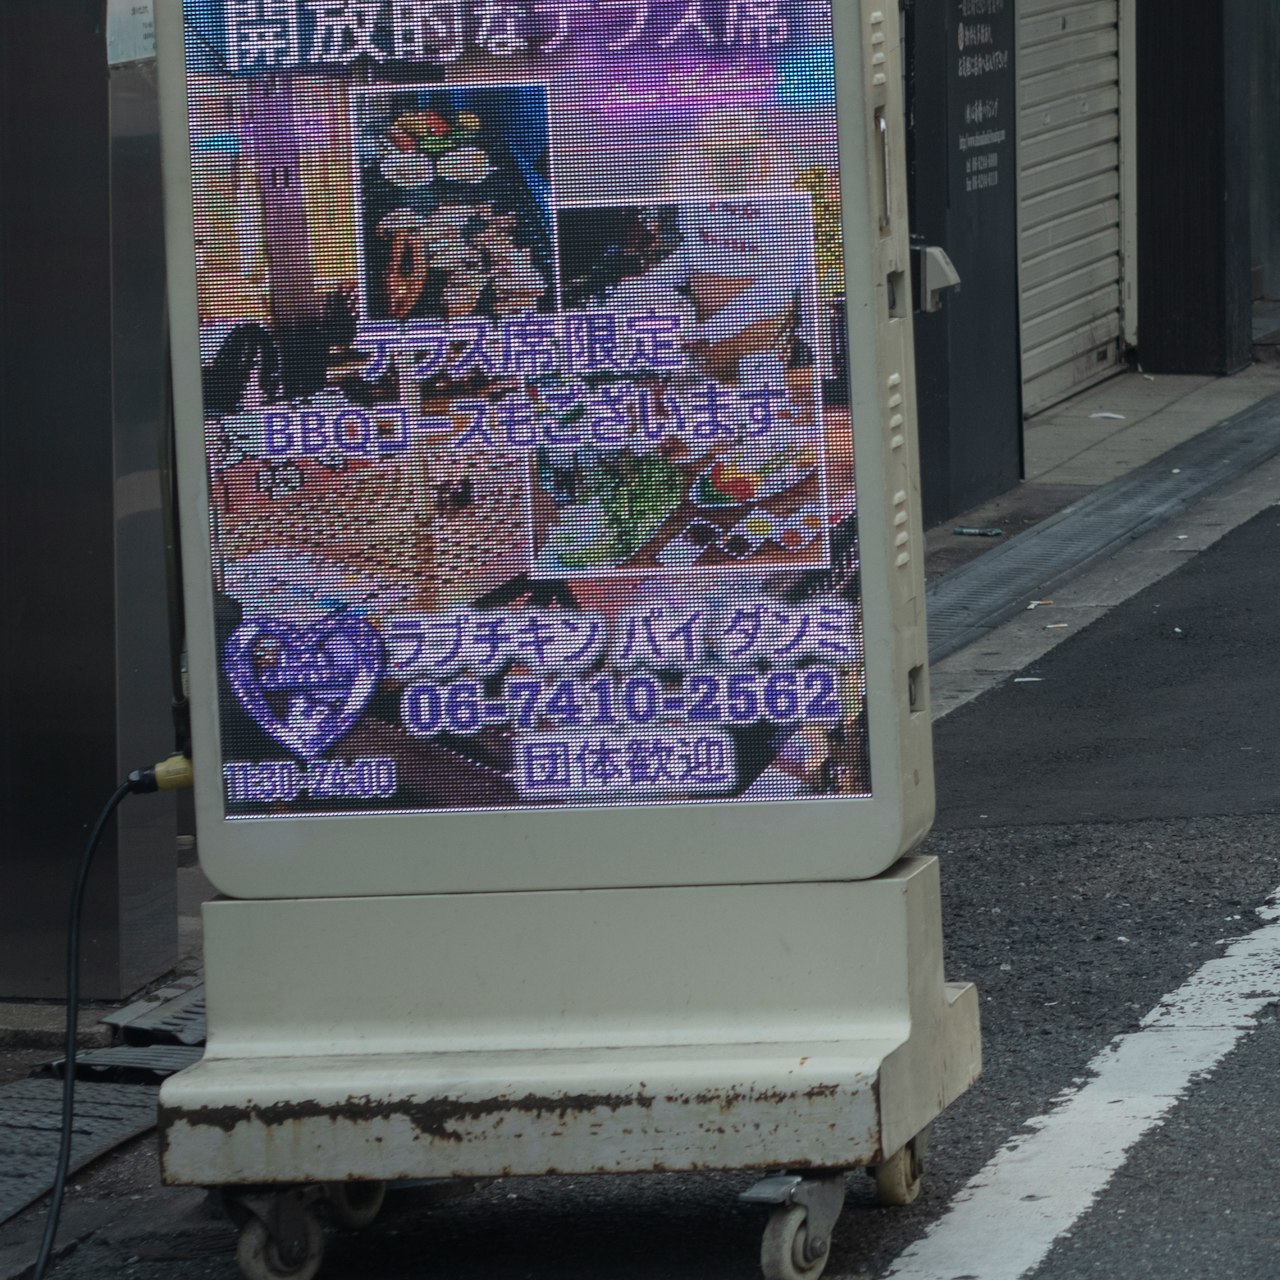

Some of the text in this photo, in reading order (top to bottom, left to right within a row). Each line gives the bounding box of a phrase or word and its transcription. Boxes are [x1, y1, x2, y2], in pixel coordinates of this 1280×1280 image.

[354, 312, 684, 382] テラス席限定
[263, 385, 792, 456] BBQコースもございます
[387, 615, 602, 670] ラブチキン
[722, 604, 854, 659] ダンミ
[404, 671, 842, 736] 06-7410-2562
[523, 739, 729, 791] 団体歓迎
